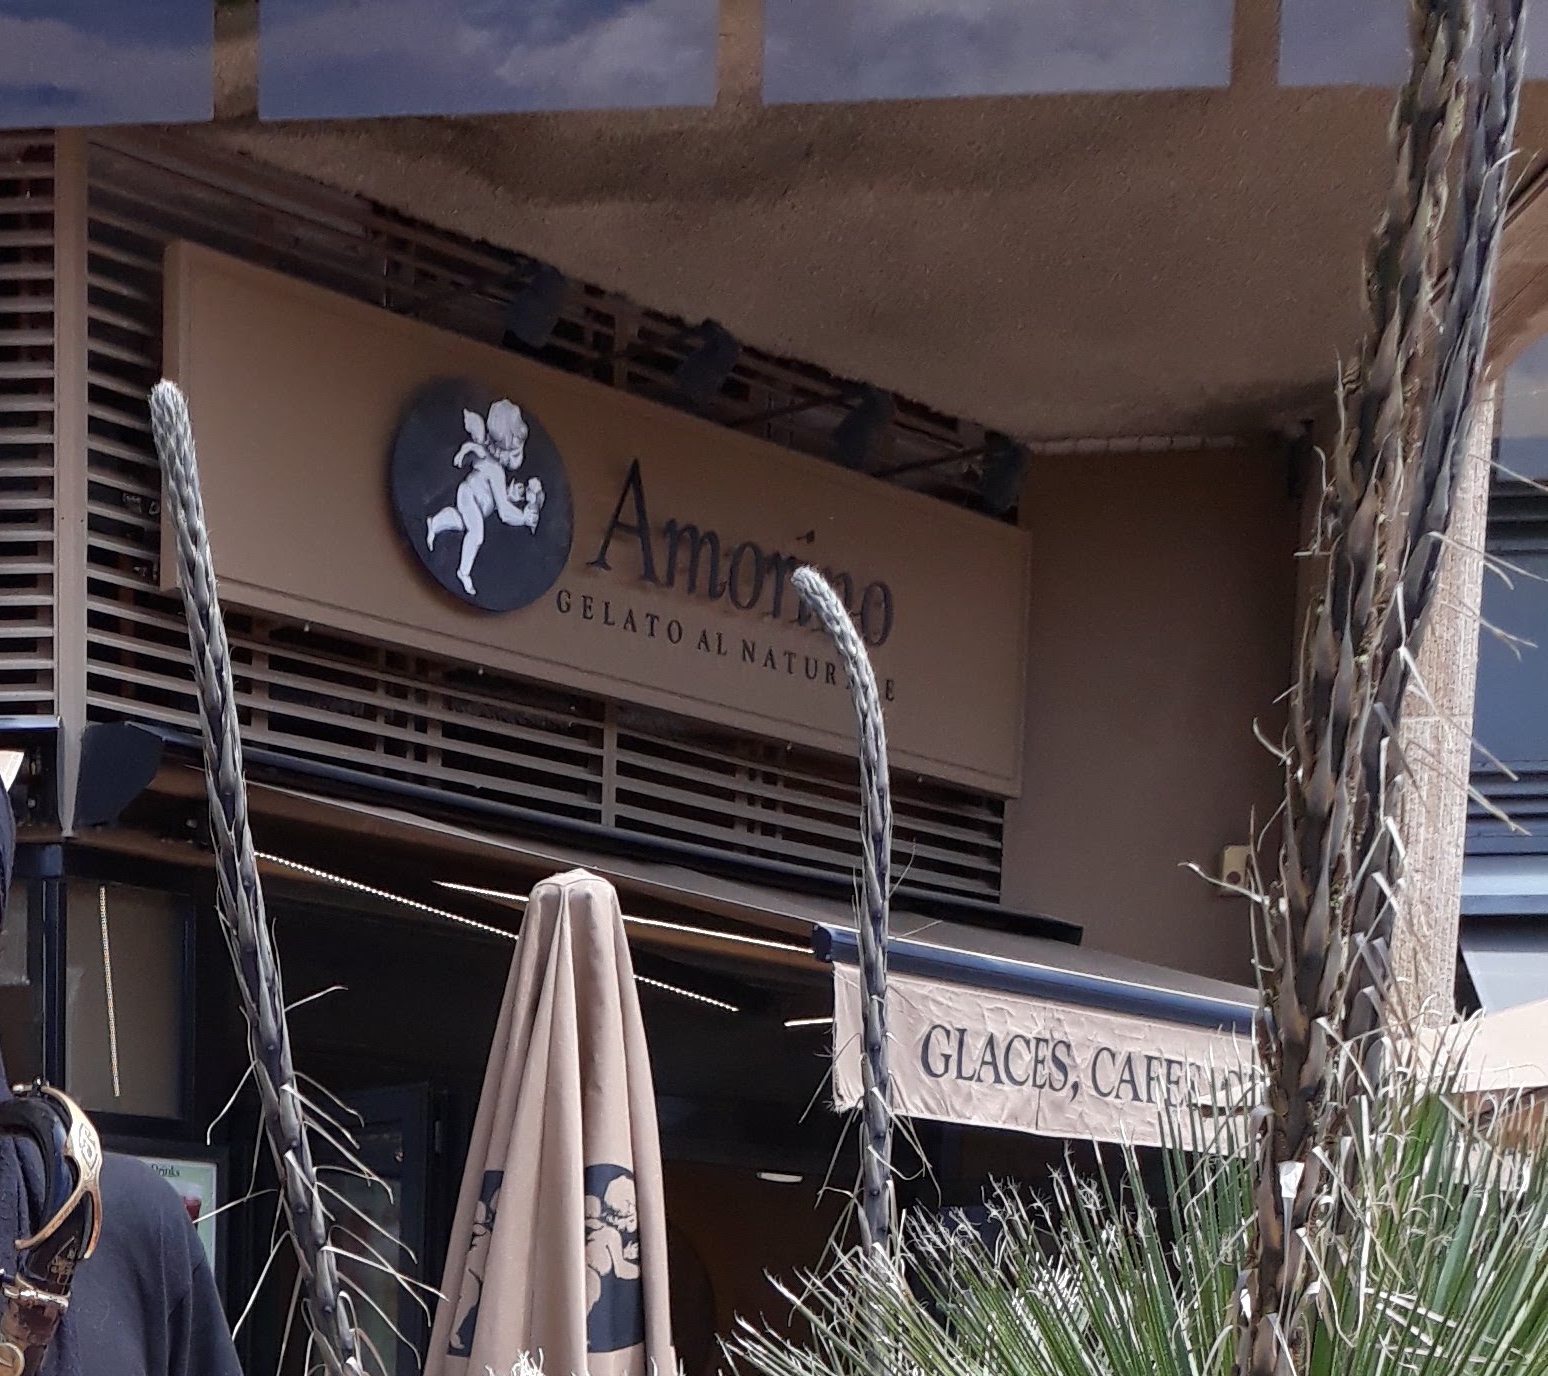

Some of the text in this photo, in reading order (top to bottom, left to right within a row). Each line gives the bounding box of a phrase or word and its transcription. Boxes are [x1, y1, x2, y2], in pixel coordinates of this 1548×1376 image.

[556, 589, 895, 701] GELATO AL NATURE
[920, 1024, 1080, 1102] GLACES,
